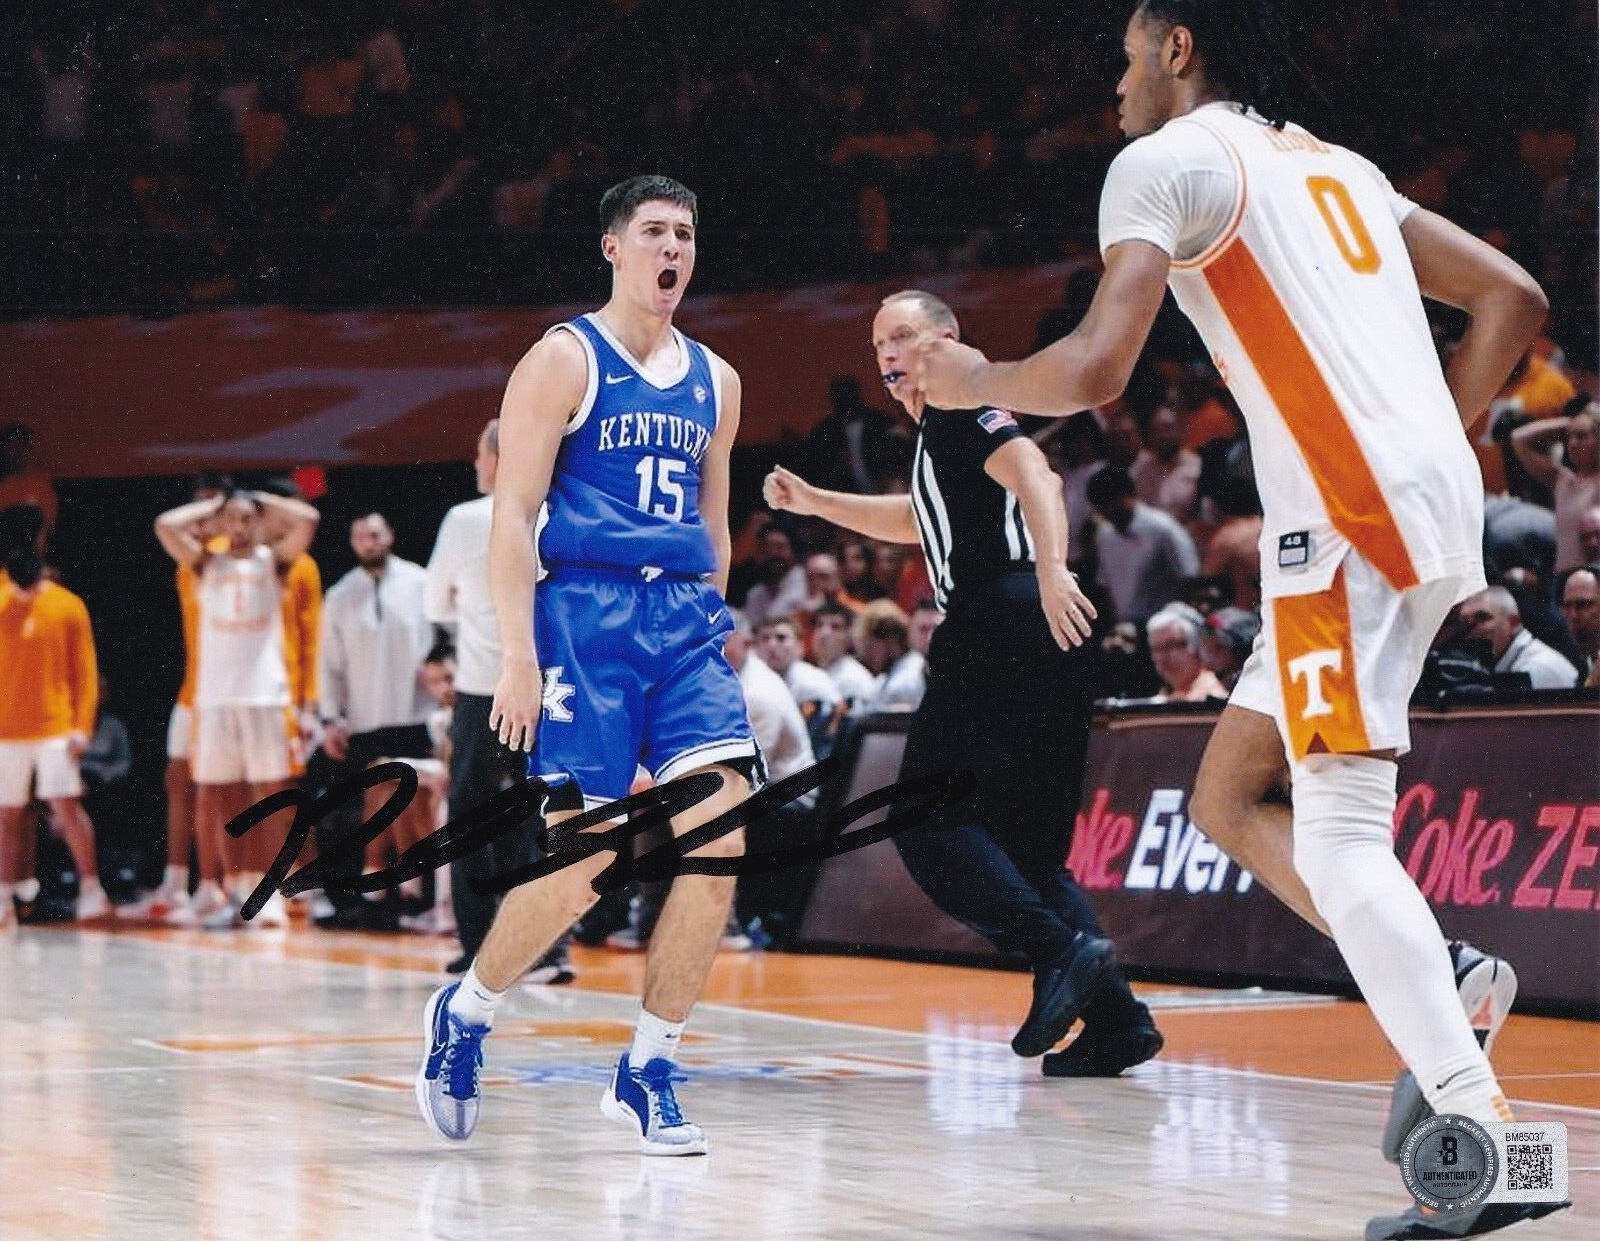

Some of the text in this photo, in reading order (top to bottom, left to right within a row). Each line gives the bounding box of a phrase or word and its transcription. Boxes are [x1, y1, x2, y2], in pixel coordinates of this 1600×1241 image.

[1306, 176, 1382, 275] 0
[635, 455, 687, 523] 15
[1287, 649, 1343, 721] T
[1511, 805, 1600, 910] ZE
[1423, 1171, 1477, 1181] AUTHENTICATED
